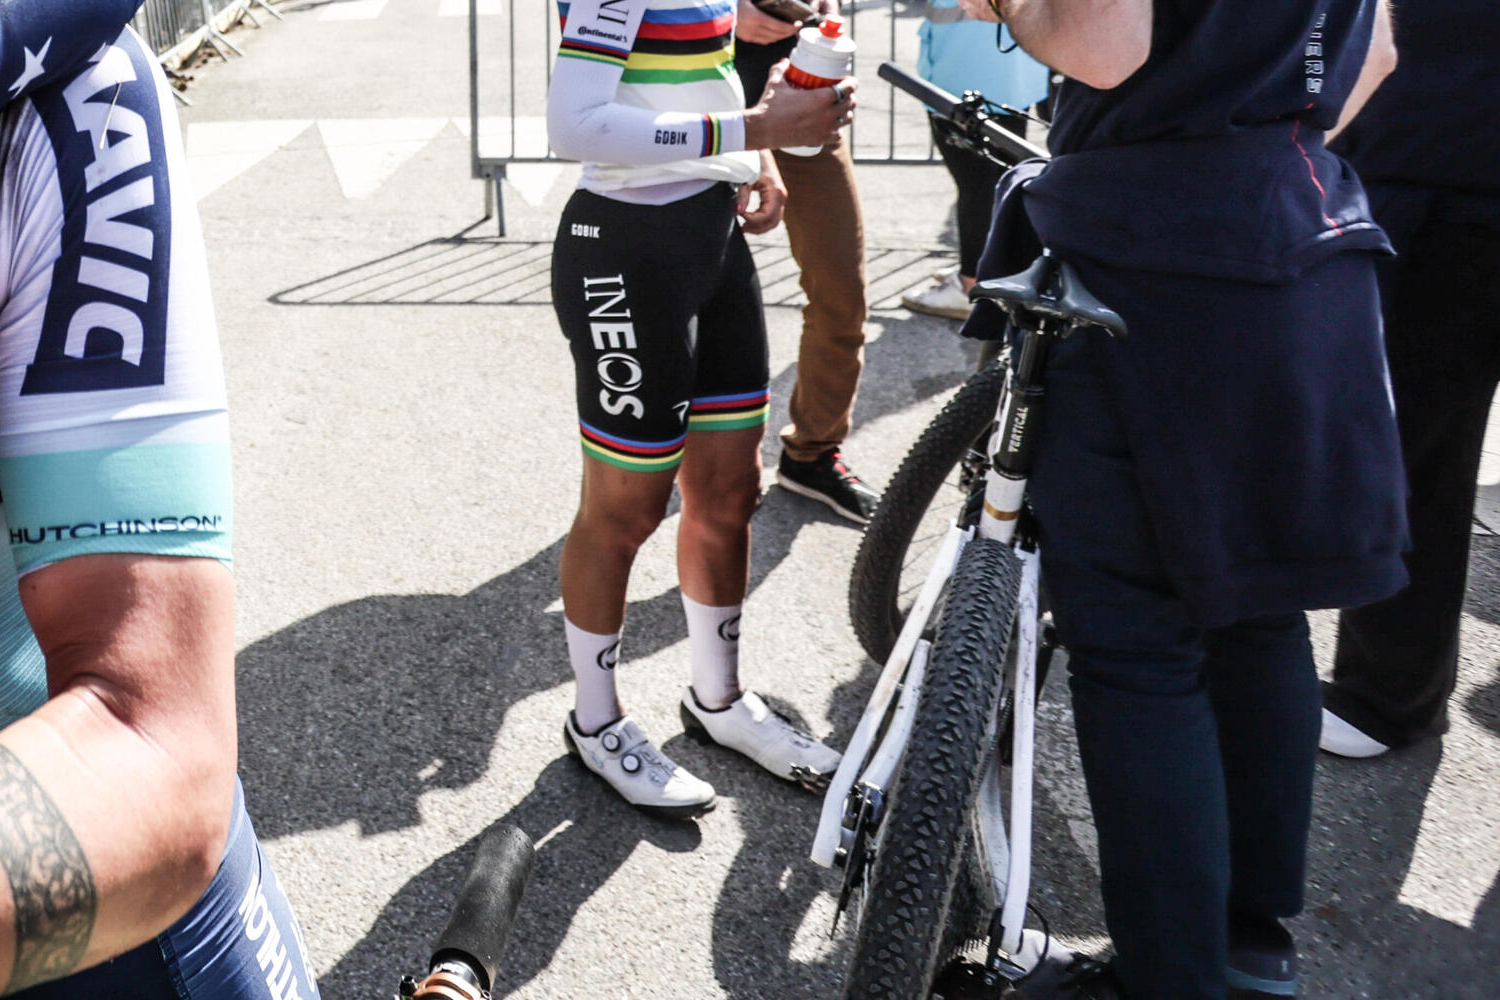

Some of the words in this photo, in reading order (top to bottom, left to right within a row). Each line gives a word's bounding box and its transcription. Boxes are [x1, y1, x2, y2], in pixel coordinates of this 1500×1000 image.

[655, 129, 688, 146] GOBIK
[571, 222, 599, 239] GOBIK
[583, 272, 644, 422] INEOS
[1008, 407, 1028, 452] VERTICAL
[9, 515, 218, 545] HUTCHINSON
